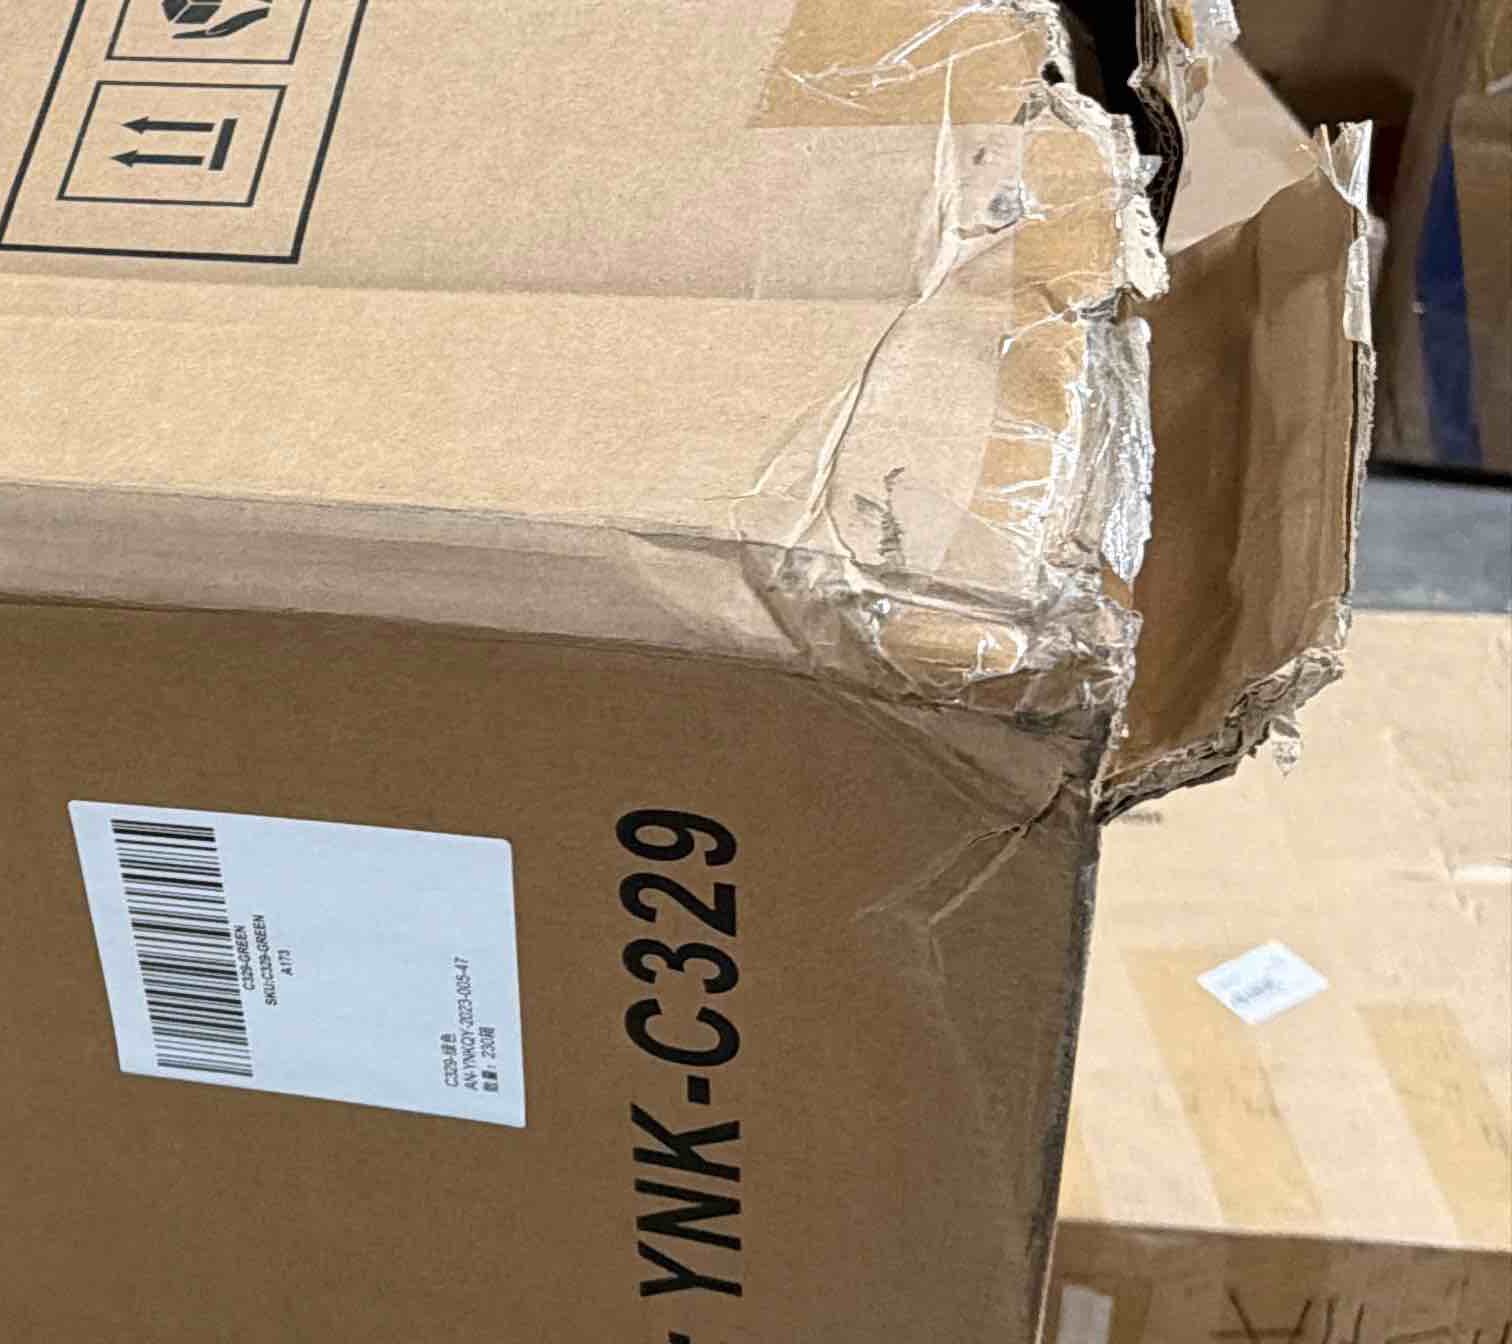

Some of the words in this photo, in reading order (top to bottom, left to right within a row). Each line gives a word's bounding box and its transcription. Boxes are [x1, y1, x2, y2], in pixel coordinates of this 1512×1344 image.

[233, 924, 256, 991] C329-GREEN
[277, 950, 294, 977] A173
[614, 807, 744, 1299] YNK-C329
